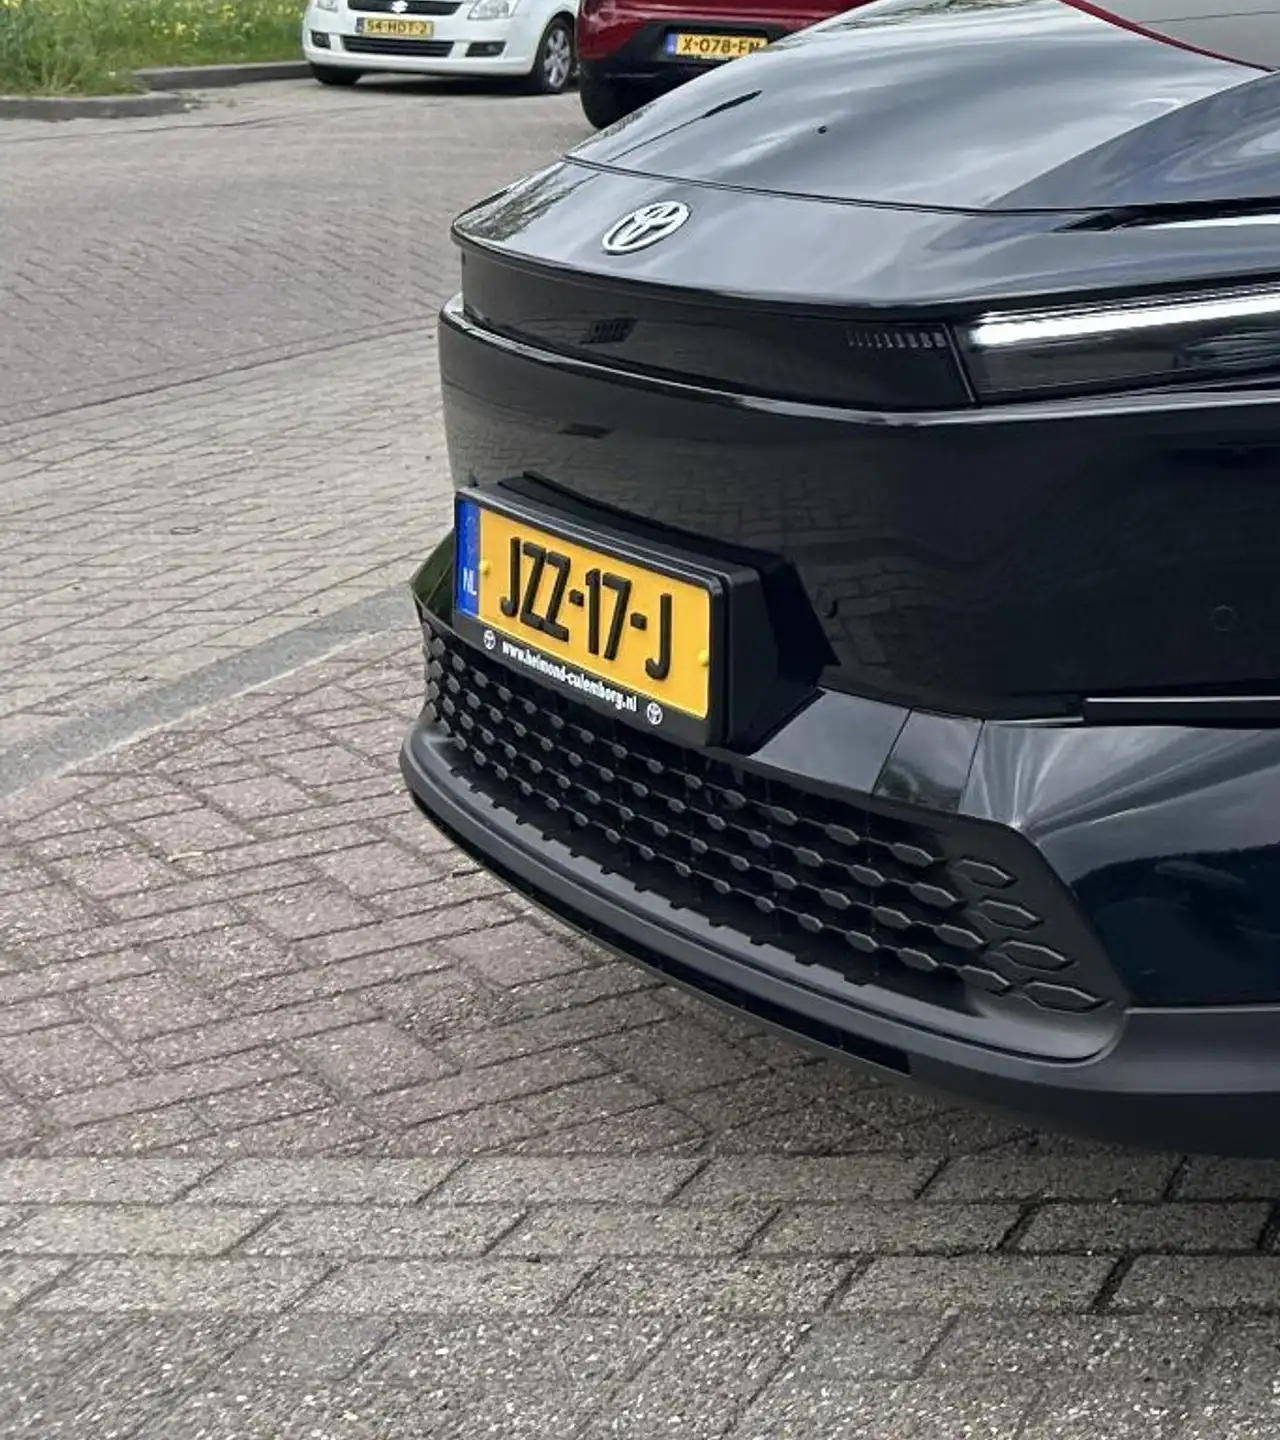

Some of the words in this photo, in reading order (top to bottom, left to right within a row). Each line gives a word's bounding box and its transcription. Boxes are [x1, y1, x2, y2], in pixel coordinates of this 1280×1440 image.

[462, 567, 478, 597] NL
[500, 536, 673, 681] JZZ-17-J
[502, 640, 638, 713] www.helmond-culemborg.nl
